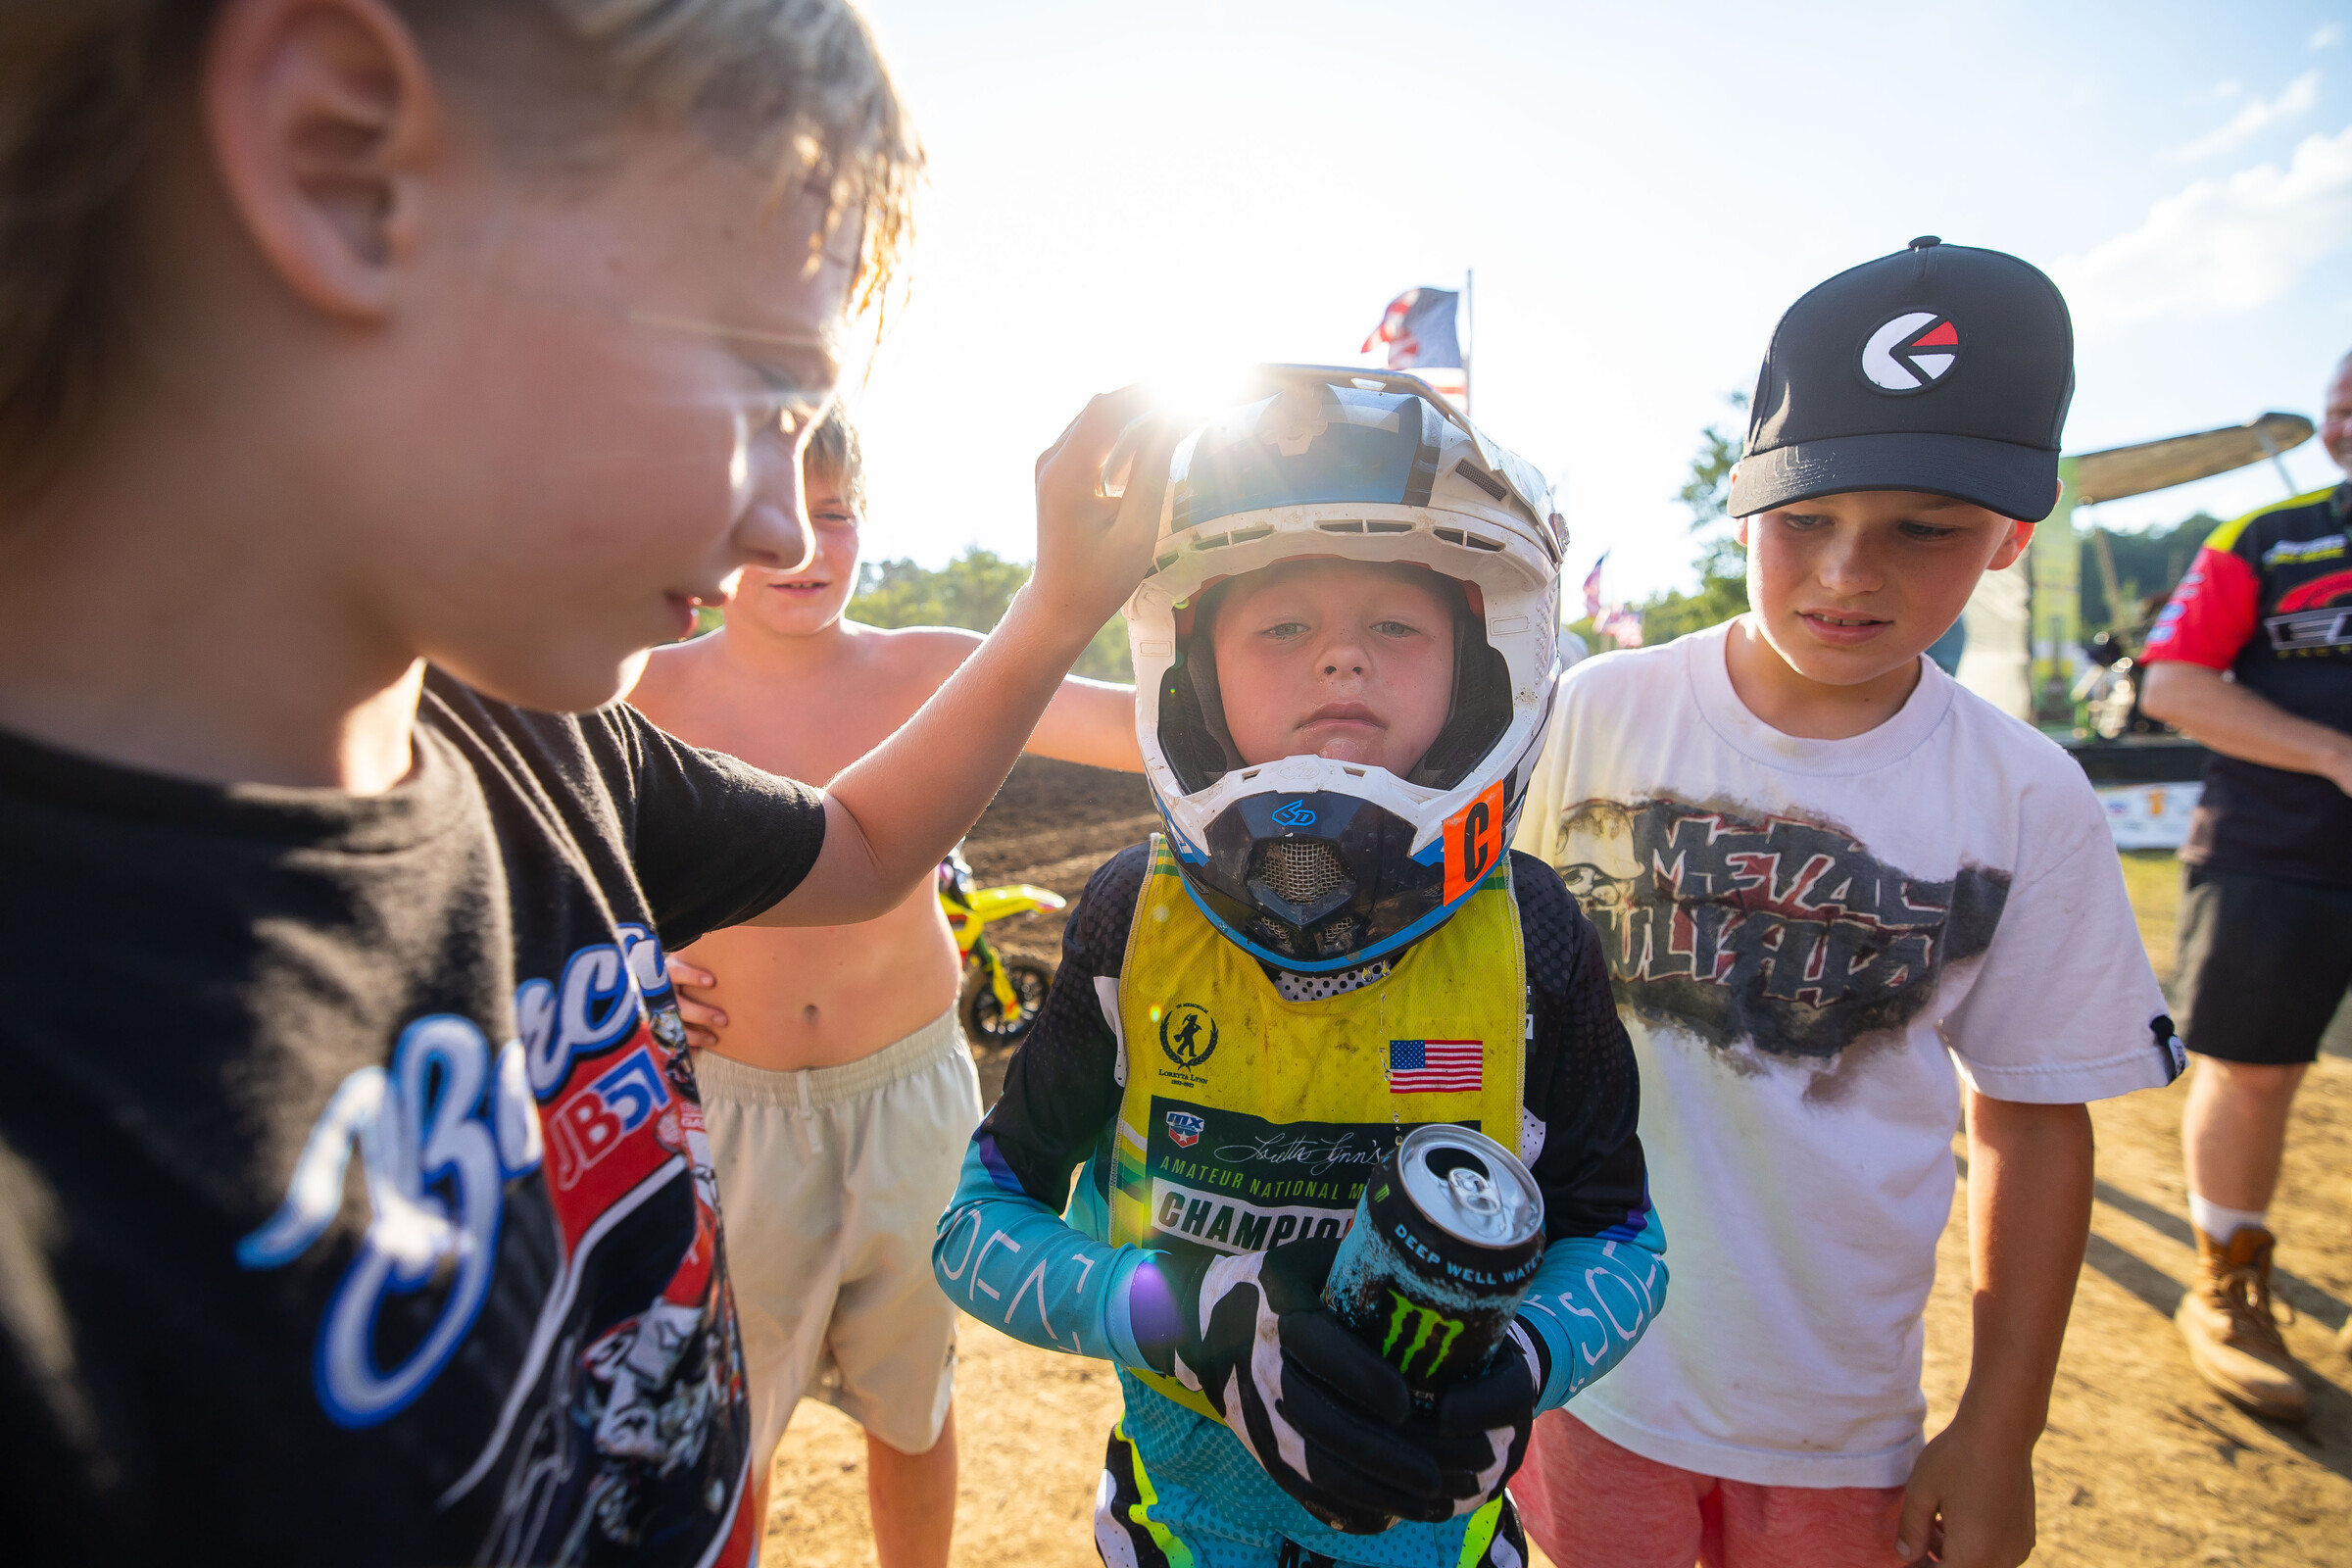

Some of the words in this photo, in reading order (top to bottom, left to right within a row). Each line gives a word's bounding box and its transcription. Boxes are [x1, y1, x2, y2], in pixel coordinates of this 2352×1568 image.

[1463, 802, 1490, 882] C
[1159, 1155, 1245, 1189] AMATEUR
[1250, 1178, 1338, 1200] NATIONAL
[1157, 1191, 1352, 1251] CHAMPIO
[1394, 1223, 1441, 1266] DEEP
[1446, 1261, 1497, 1286] WELL
[1503, 1249, 1544, 1284] WATER
